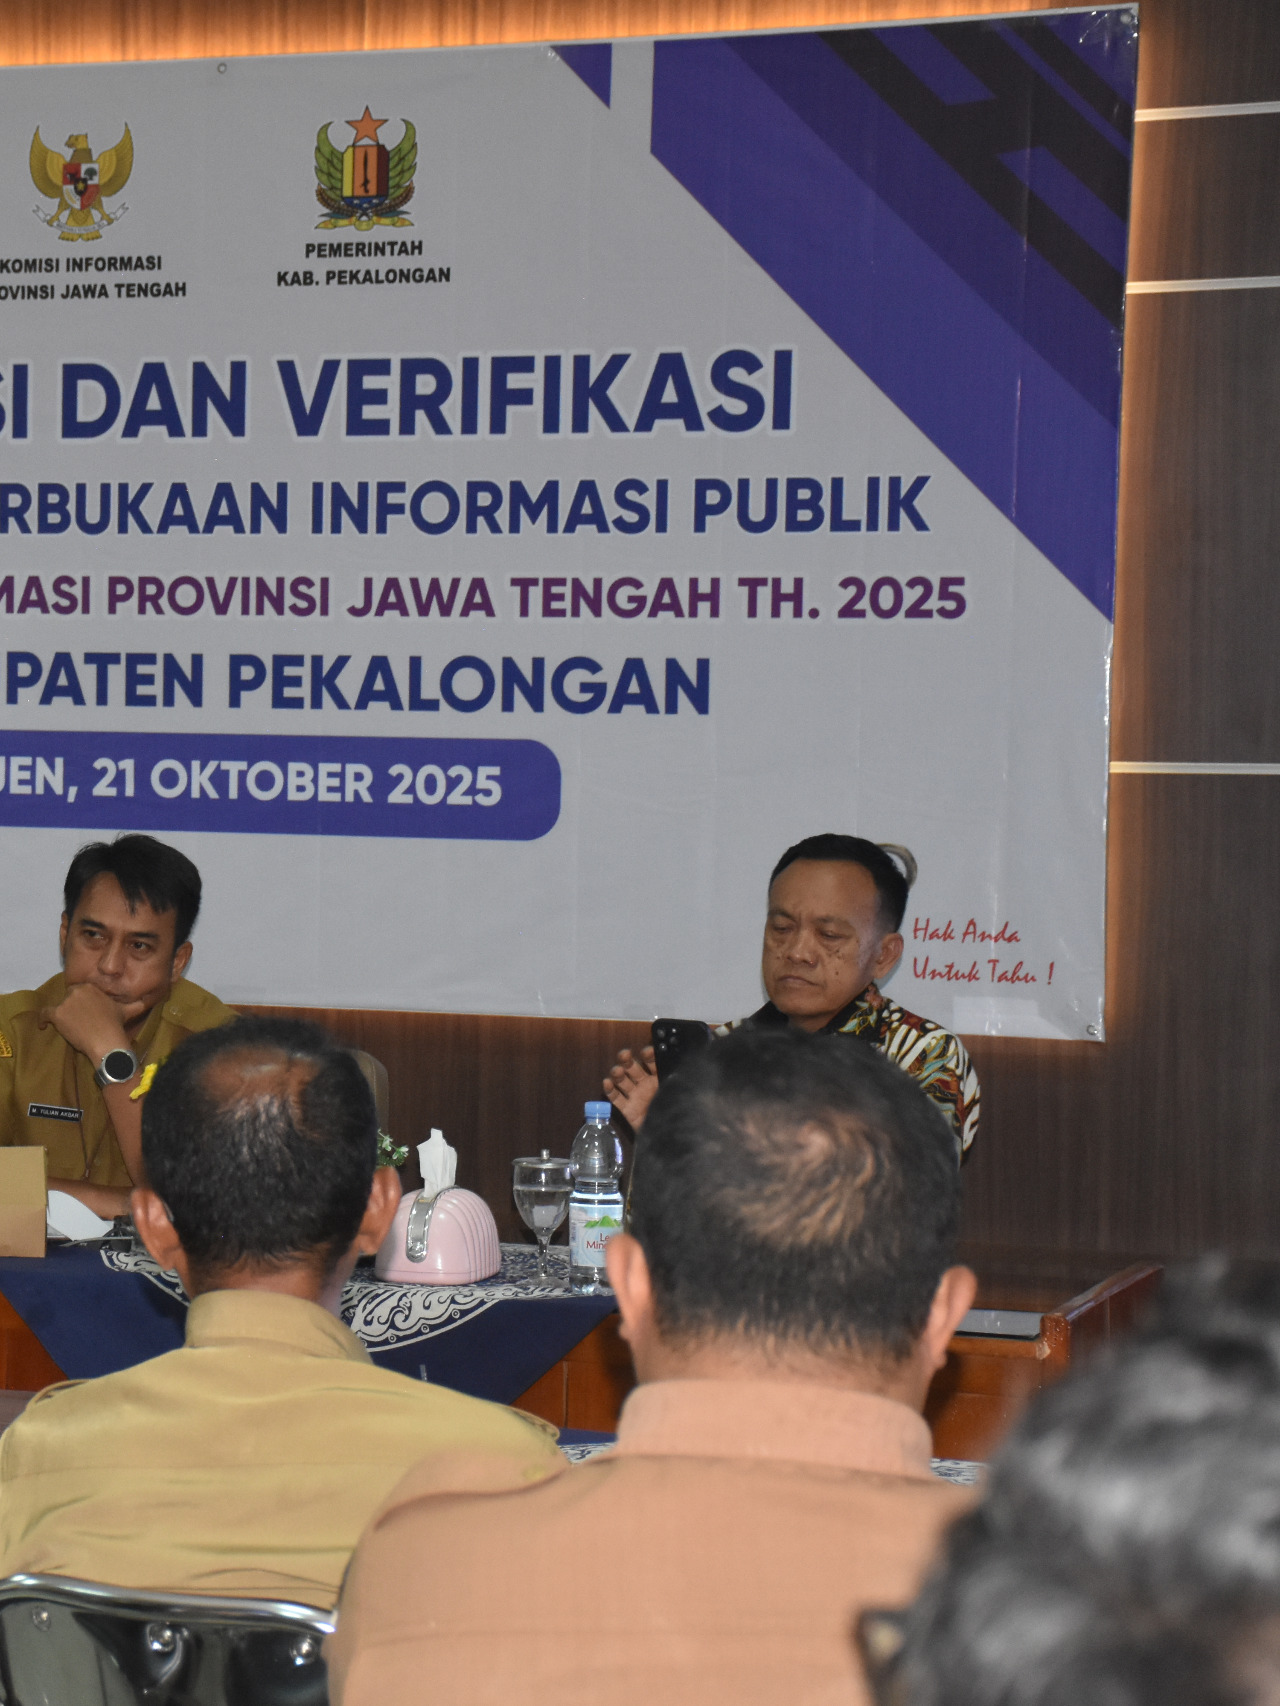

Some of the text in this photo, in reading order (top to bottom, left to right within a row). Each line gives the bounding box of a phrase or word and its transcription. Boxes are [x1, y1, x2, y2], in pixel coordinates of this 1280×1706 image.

[306, 240, 423, 257] PEMERINTAH
[0, 255, 162, 274] KOMISI INFORMASI
[277, 267, 451, 287] KAB. PEKALONGAN
[61, 284, 110, 300] JAWA
[114, 282, 187, 299] TENGAH
[62, 361, 247, 439] DAN
[277, 349, 793, 437] VERIFIKASI
[312, 479, 669, 536] INFORMASI
[694, 476, 932, 534] PUBLIK
[108, 576, 330, 618] PROVINSI
[347, 577, 496, 618] JAWA
[510, 577, 721, 619] TENGAH
[738, 577, 820, 619] TH.
[838, 576, 967, 620] 2025
[229, 654, 711, 715] PEKALONGAN
[93, 758, 135, 797] 21
[151, 759, 373, 803] OKTOBER
[388, 764, 502, 807] 2025
[913, 917, 1022, 943] Hak Anda
[913, 955, 981, 983] Untuk
[987, 959, 1037, 984] Tahu
